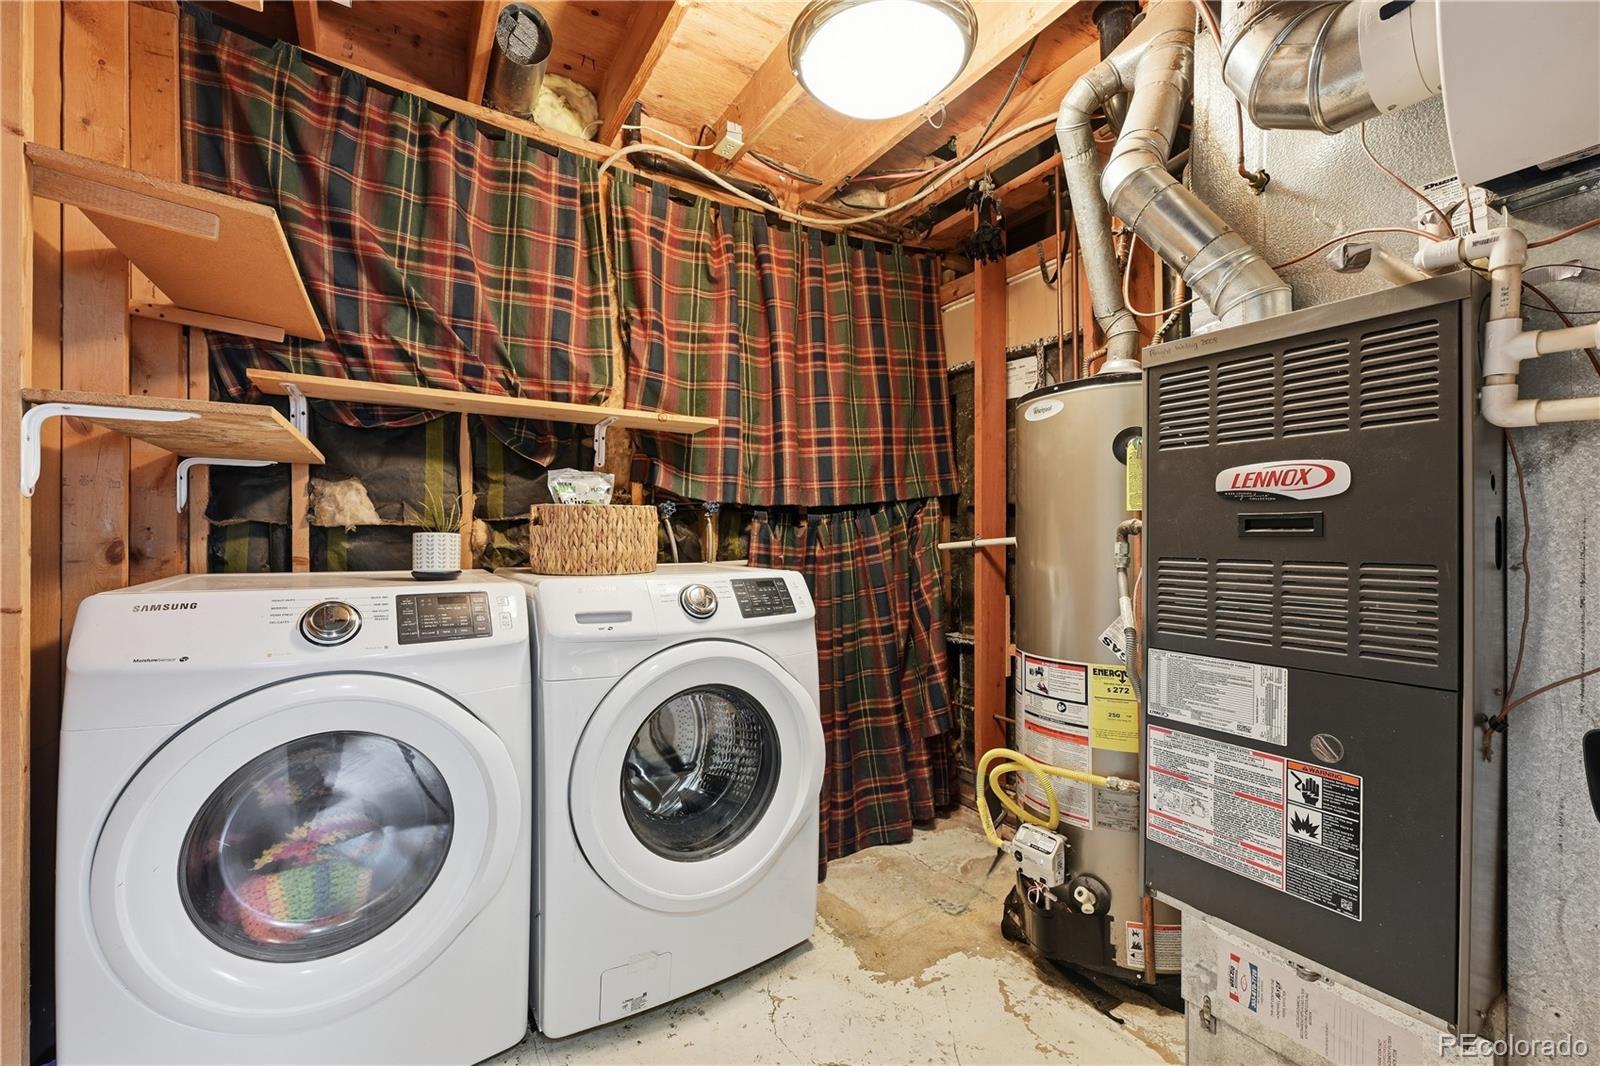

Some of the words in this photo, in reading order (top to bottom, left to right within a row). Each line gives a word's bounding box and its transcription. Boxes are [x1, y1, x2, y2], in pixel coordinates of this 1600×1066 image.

[1230, 467, 1313, 490] LENNOX
[132, 602, 198, 613] SAMSUNG
[1113, 686, 1130, 694] 272
[1309, 767, 1343, 780] WARNING
